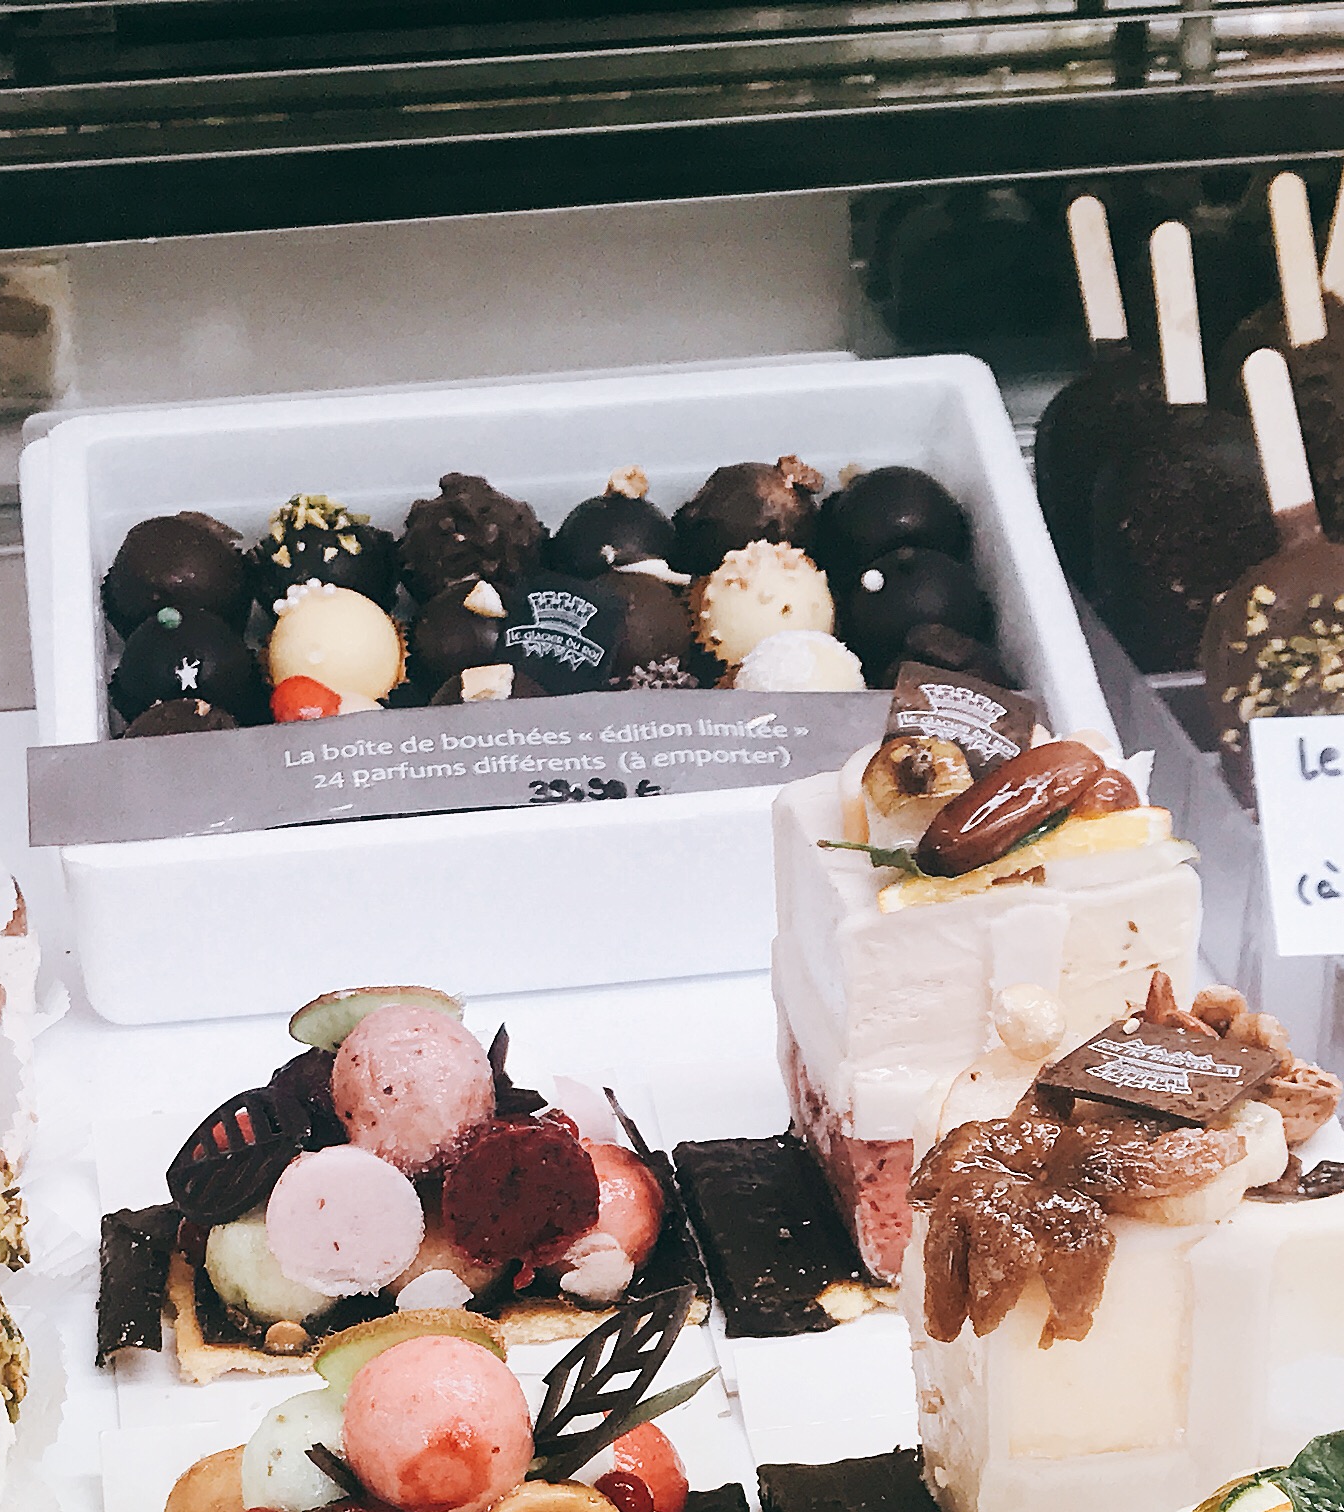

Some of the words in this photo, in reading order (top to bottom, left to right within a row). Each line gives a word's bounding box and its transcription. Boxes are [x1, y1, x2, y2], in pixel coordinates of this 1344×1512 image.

[284, 749, 316, 769] La
[322, 739, 393, 761] boîte
[400, 735, 436, 754] de
[440, 727, 571, 751] bouchées
[599, 720, 693, 744] édition
[1297, 736, 1344, 781] Le
[313, 771, 345, 790] 24
[351, 761, 467, 789] parfums
[473, 753, 607, 776] différents
[617, 750, 646, 774] (à
[654, 745, 793, 769] emporter)
